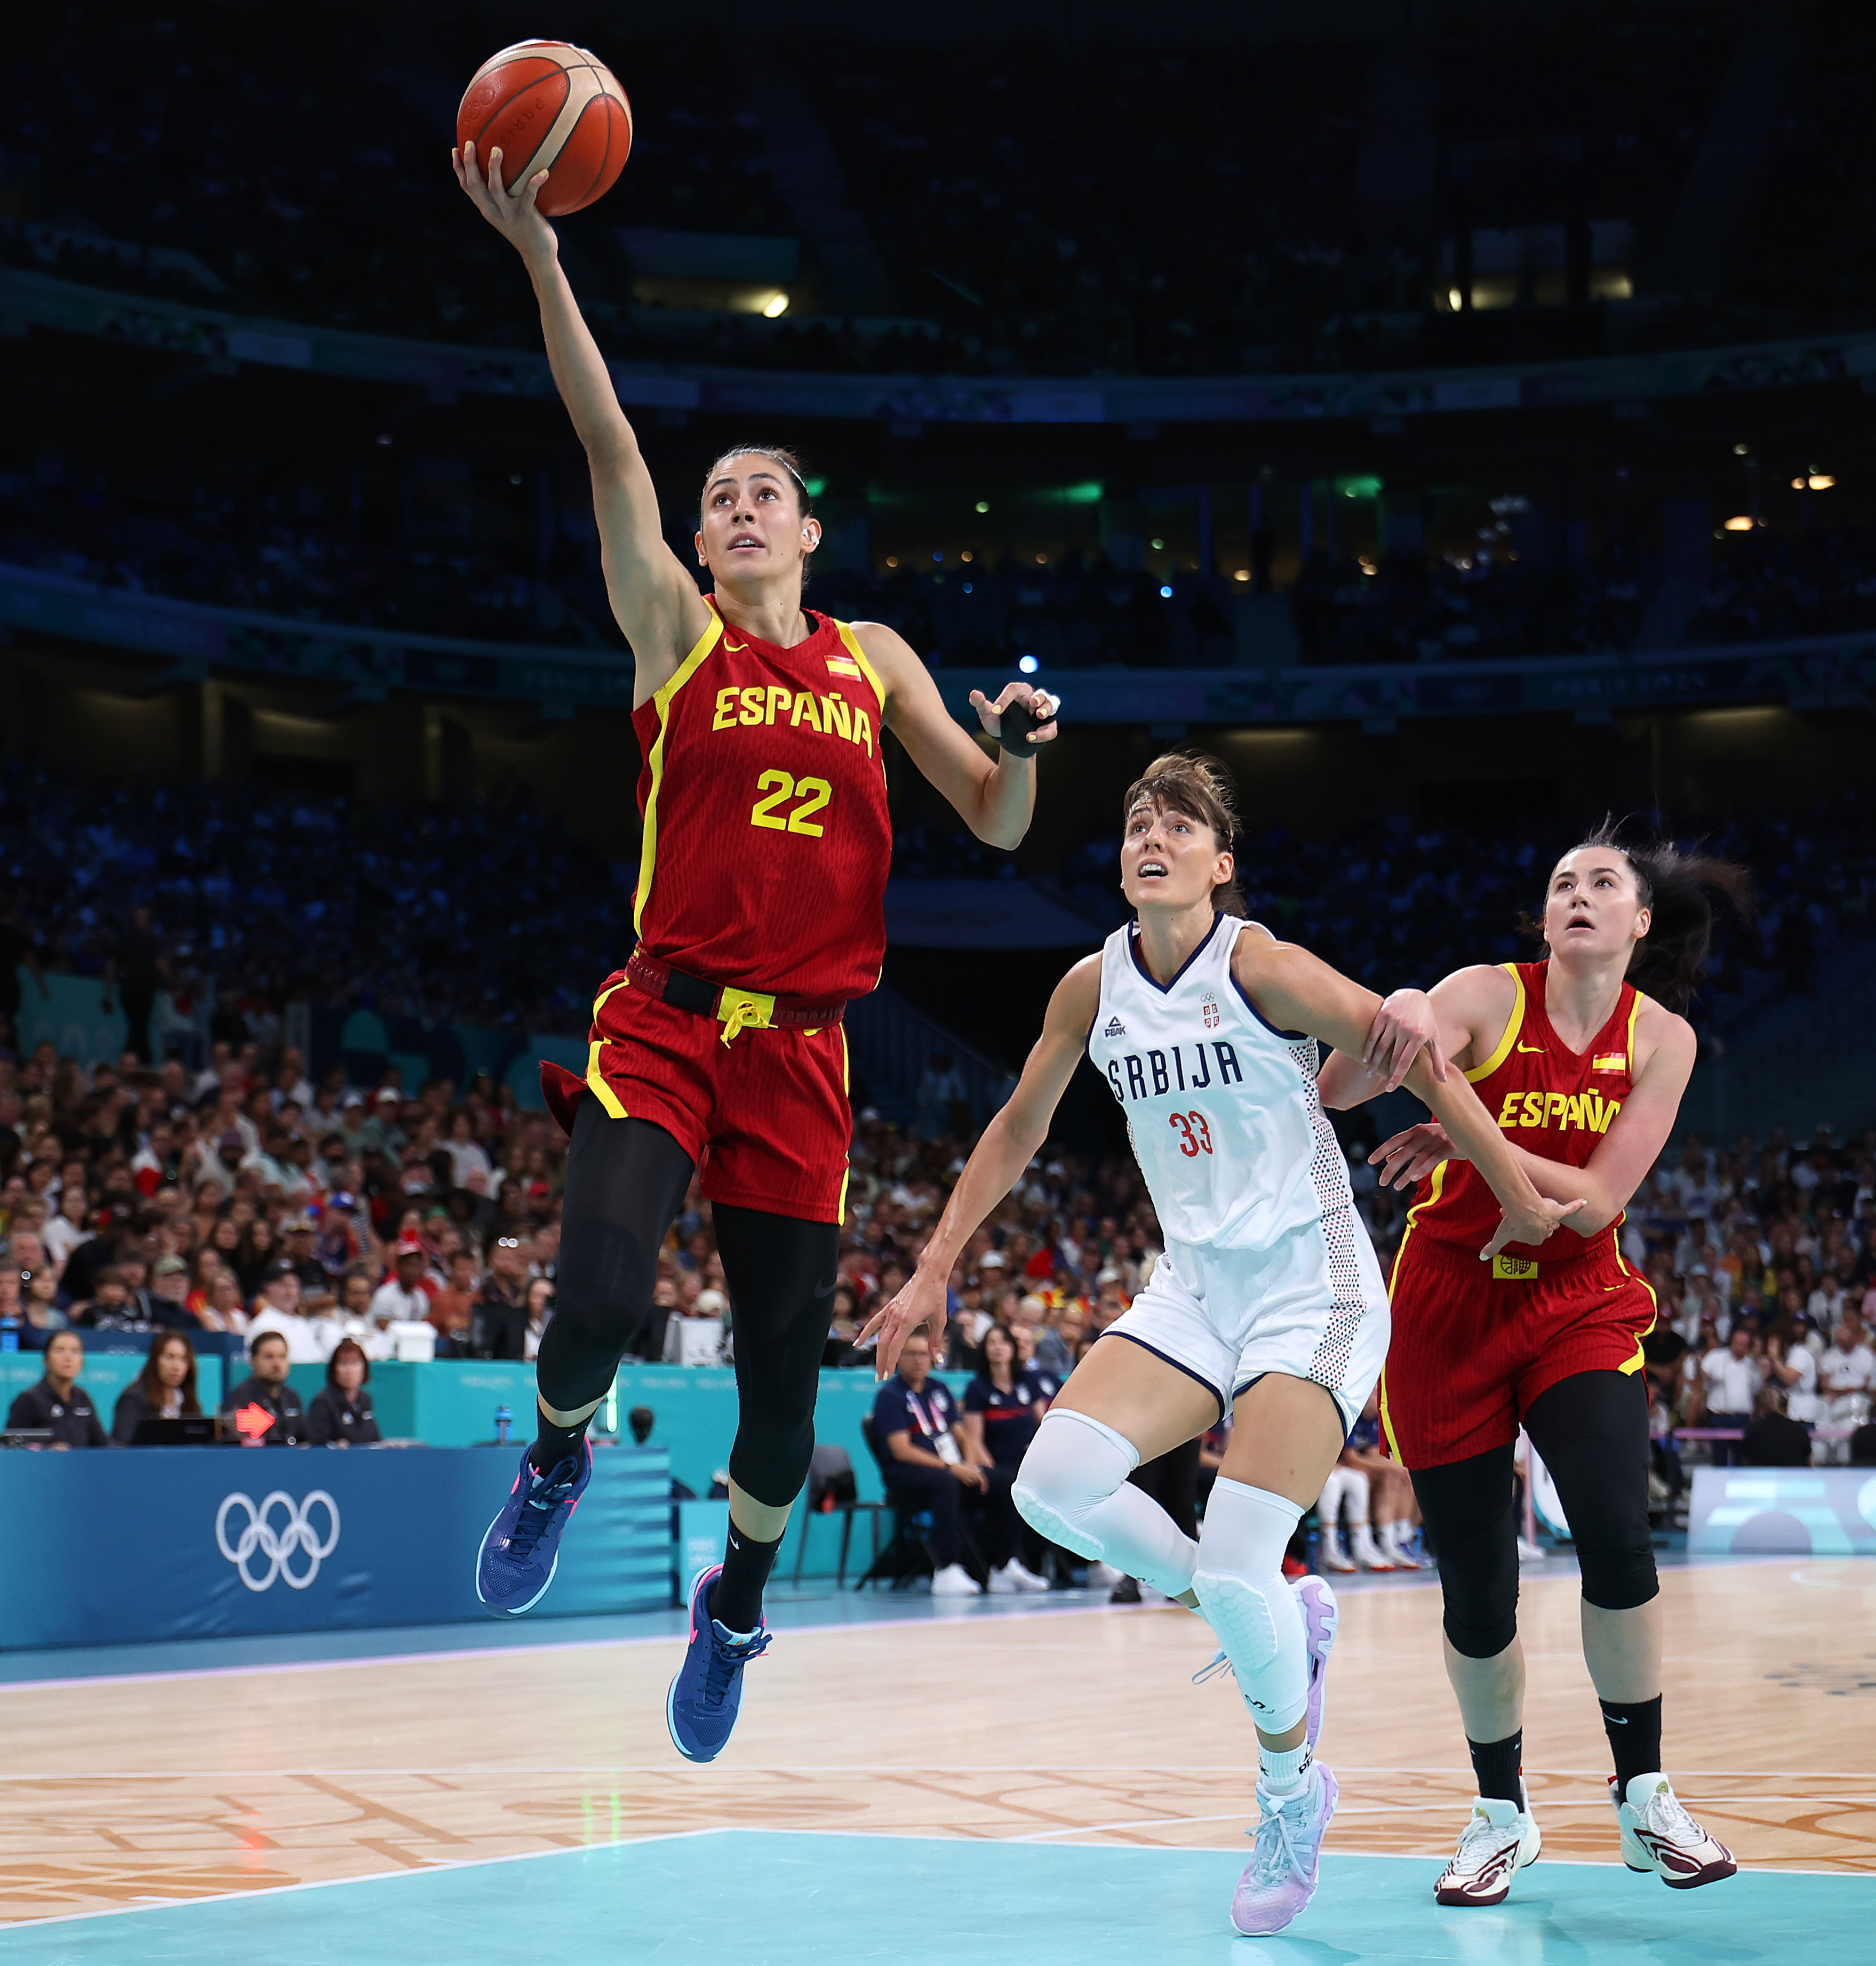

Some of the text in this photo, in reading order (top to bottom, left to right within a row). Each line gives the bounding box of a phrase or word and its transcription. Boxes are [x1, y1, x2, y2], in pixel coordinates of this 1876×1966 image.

[500, 98, 545, 148] PARIS
[712, 686, 873, 759] ESPAÑA
[751, 769, 832, 837] 22
[1104, 1026, 1127, 1038] PEAK
[1107, 1041, 1243, 1102] SRBIJA
[1169, 1110, 1213, 1157] 33
